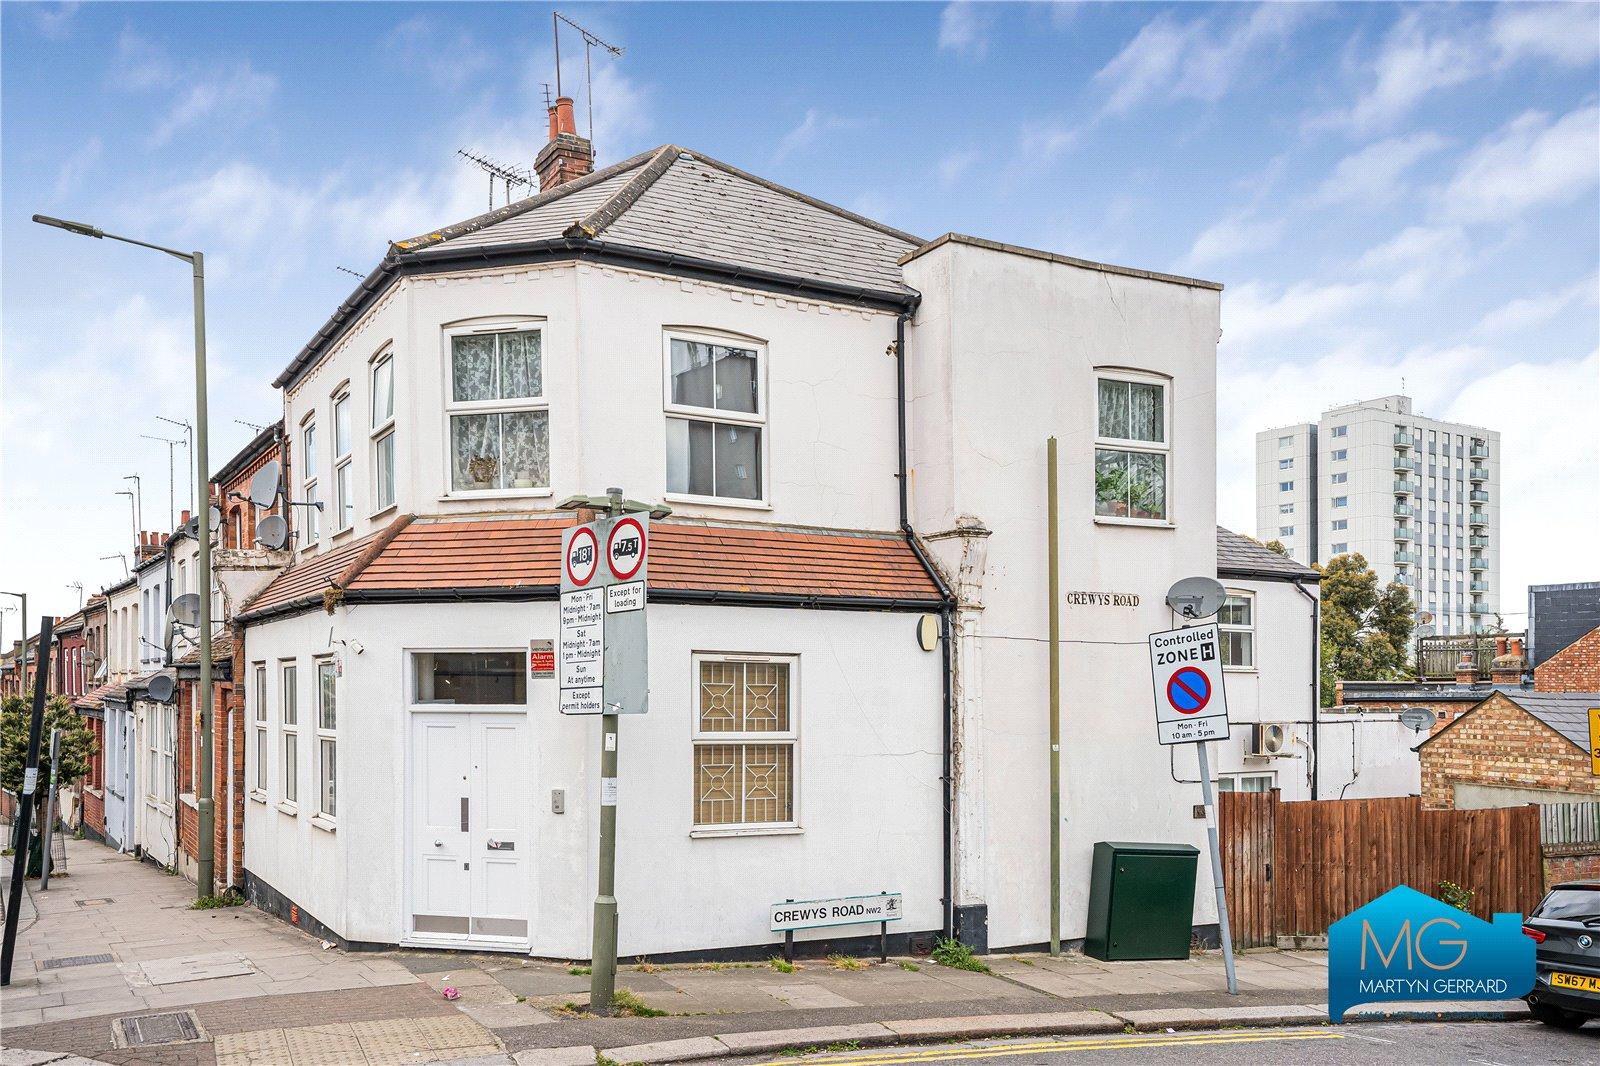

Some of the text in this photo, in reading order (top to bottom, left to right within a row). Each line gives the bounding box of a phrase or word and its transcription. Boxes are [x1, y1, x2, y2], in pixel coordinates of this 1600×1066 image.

[579, 546, 592, 562] 18T
[571, 595, 582, 603] Mon
[586, 592, 594, 601] Fri
[609, 587, 642, 598] Except for
[614, 598, 637, 608] loading
[1067, 592, 1140, 607] CREWYS ROAD
[562, 605, 586, 614] Midnight
[590, 602, 600, 610] 7am
[562, 616, 574, 625] 9pm
[578, 613, 601, 622] Midnight
[576, 630, 586, 638] Sat
[1154, 629, 1214, 648] Controlled
[562, 640, 586, 650] Midnight
[589, 638, 600, 646] 7am
[577, 650, 600, 658] Midnight
[1157, 643, 1214, 665] ZONE H
[576, 665, 586, 673] Sun
[574, 676, 596, 684] anytime
[572, 692, 590, 700] Except
[562, 702, 600, 710] permit holders
[774, 904, 882, 922] CREWYS ROAD NW2
[1557, 974, 1586, 987] SW67
